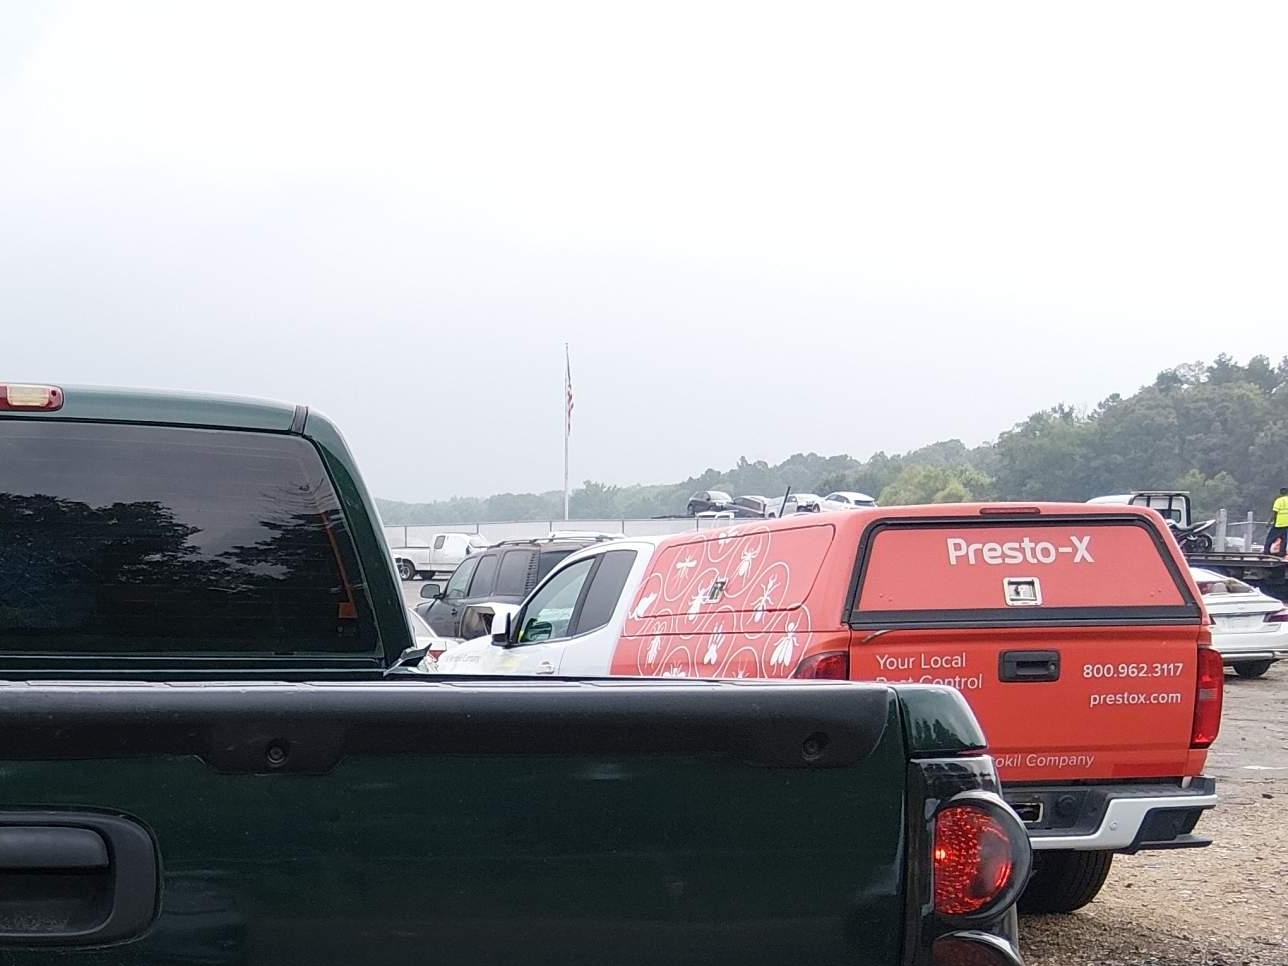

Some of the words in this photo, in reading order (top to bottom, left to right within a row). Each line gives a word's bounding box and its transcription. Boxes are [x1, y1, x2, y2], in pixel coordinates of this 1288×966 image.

[946, 535, 1096, 566] Presto-X
[876, 654, 916, 670] Your
[920, 653, 967, 669] Local
[1083, 663, 1184, 678] 800.962.3117
[1090, 692, 1182, 708] prestox.com
[995, 754, 1021, 768] okil
[1026, 753, 1095, 769] Company
